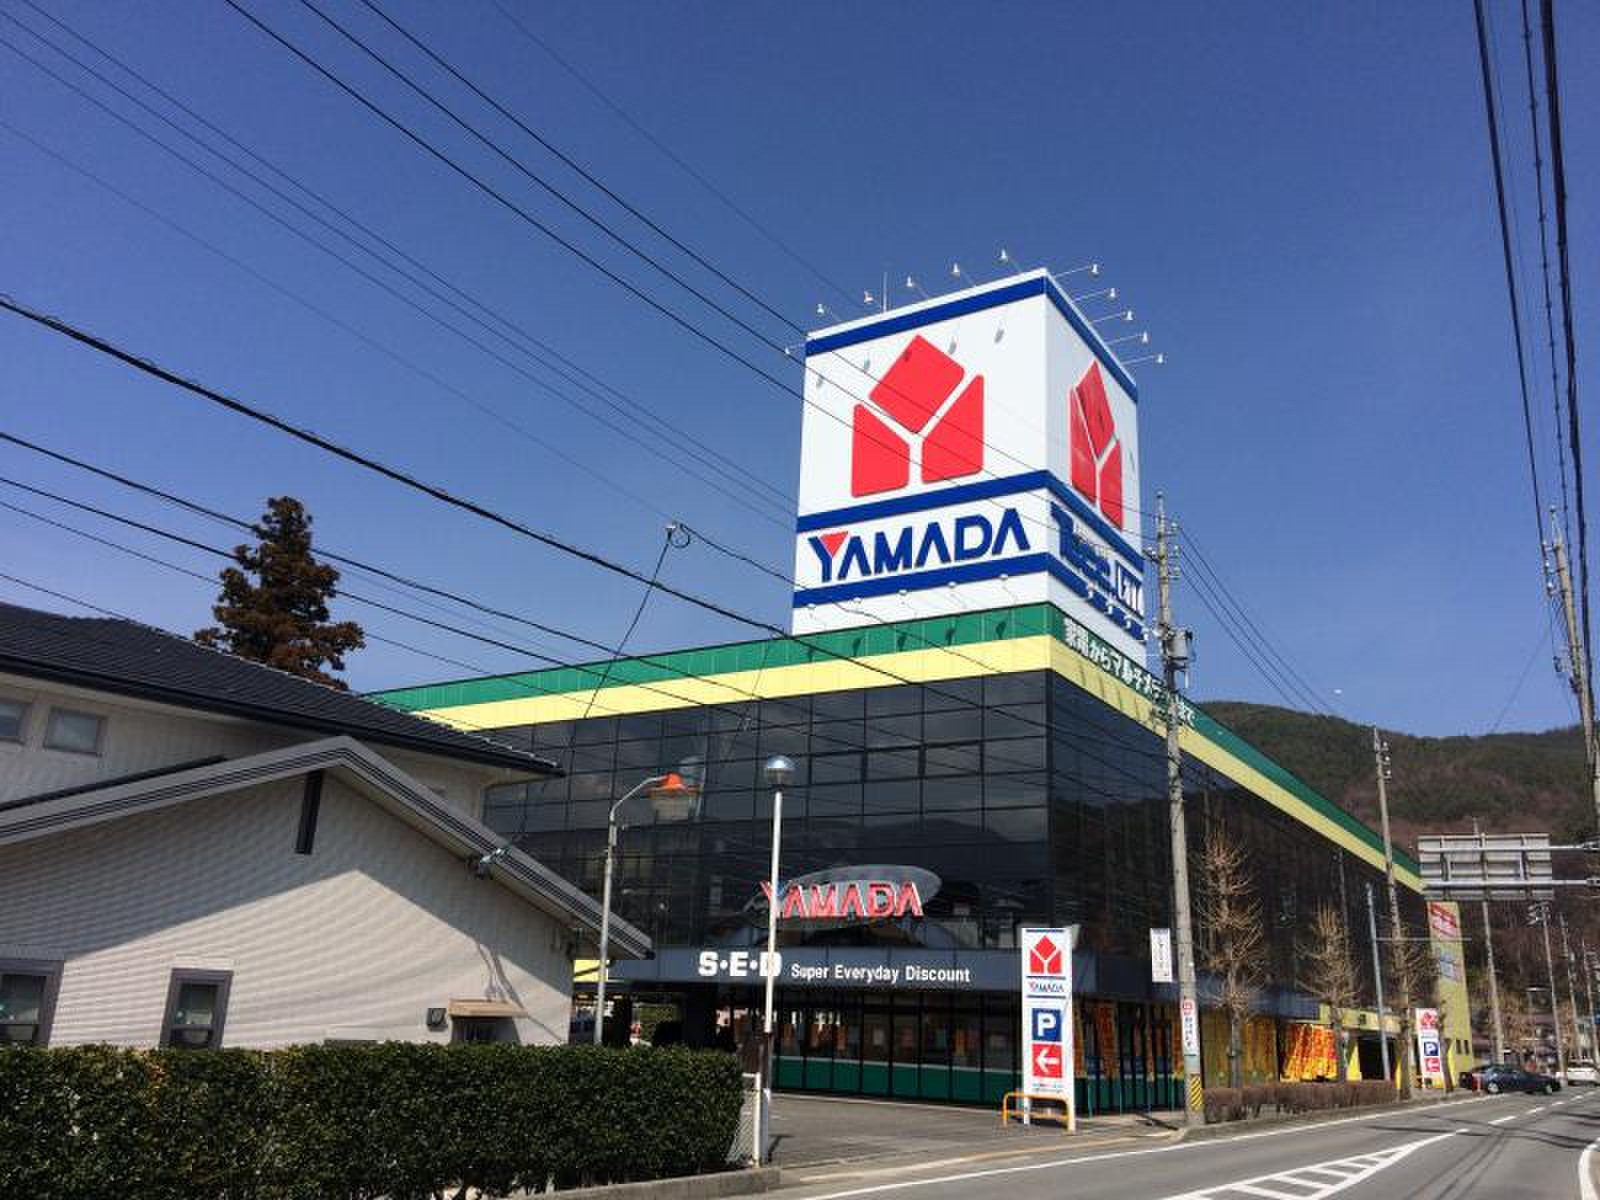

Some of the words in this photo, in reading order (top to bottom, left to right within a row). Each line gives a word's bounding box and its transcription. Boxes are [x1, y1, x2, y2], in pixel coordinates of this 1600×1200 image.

[807, 508, 1031, 583] YAMADA
[760, 880, 924, 918] YAMADA
[791, 963, 828, 981] Super
[835, 964, 899, 984] Everyday
[905, 966, 970, 983] Discount
[1028, 981, 1065, 993] YAMADA
[1037, 1013, 1057, 1037] P
[1425, 1042, 1437, 1056] P
